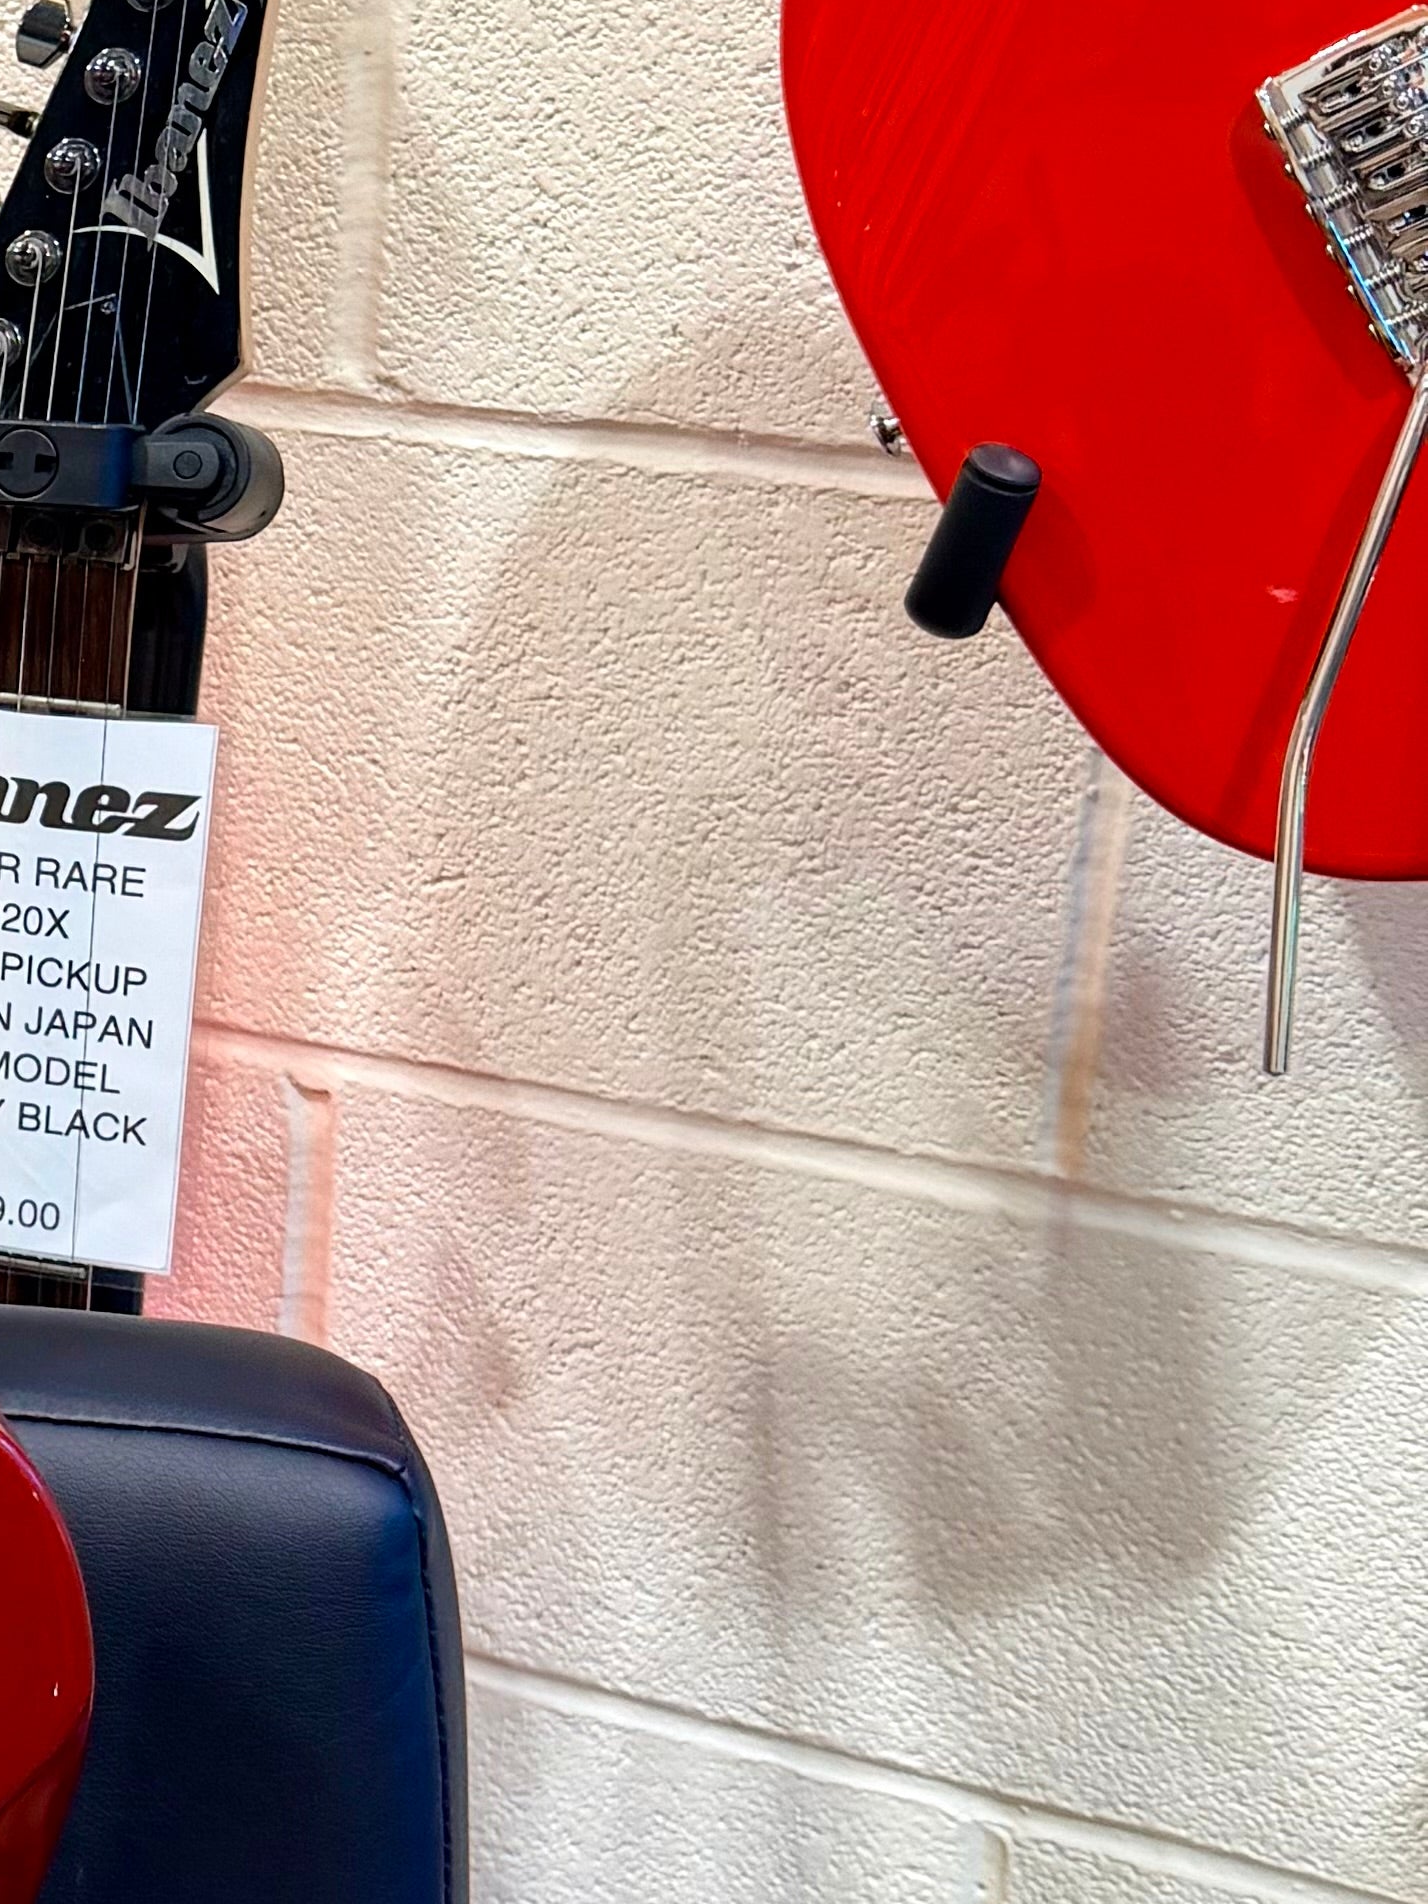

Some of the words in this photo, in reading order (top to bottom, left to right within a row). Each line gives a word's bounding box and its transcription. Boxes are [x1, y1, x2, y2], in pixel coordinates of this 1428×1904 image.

[35, 858, 146, 898] RARE
[0, 951, 148, 996] PICKUP
[24, 1007, 153, 1049] JAPAN
[18, 1102, 147, 1145] BLACK
